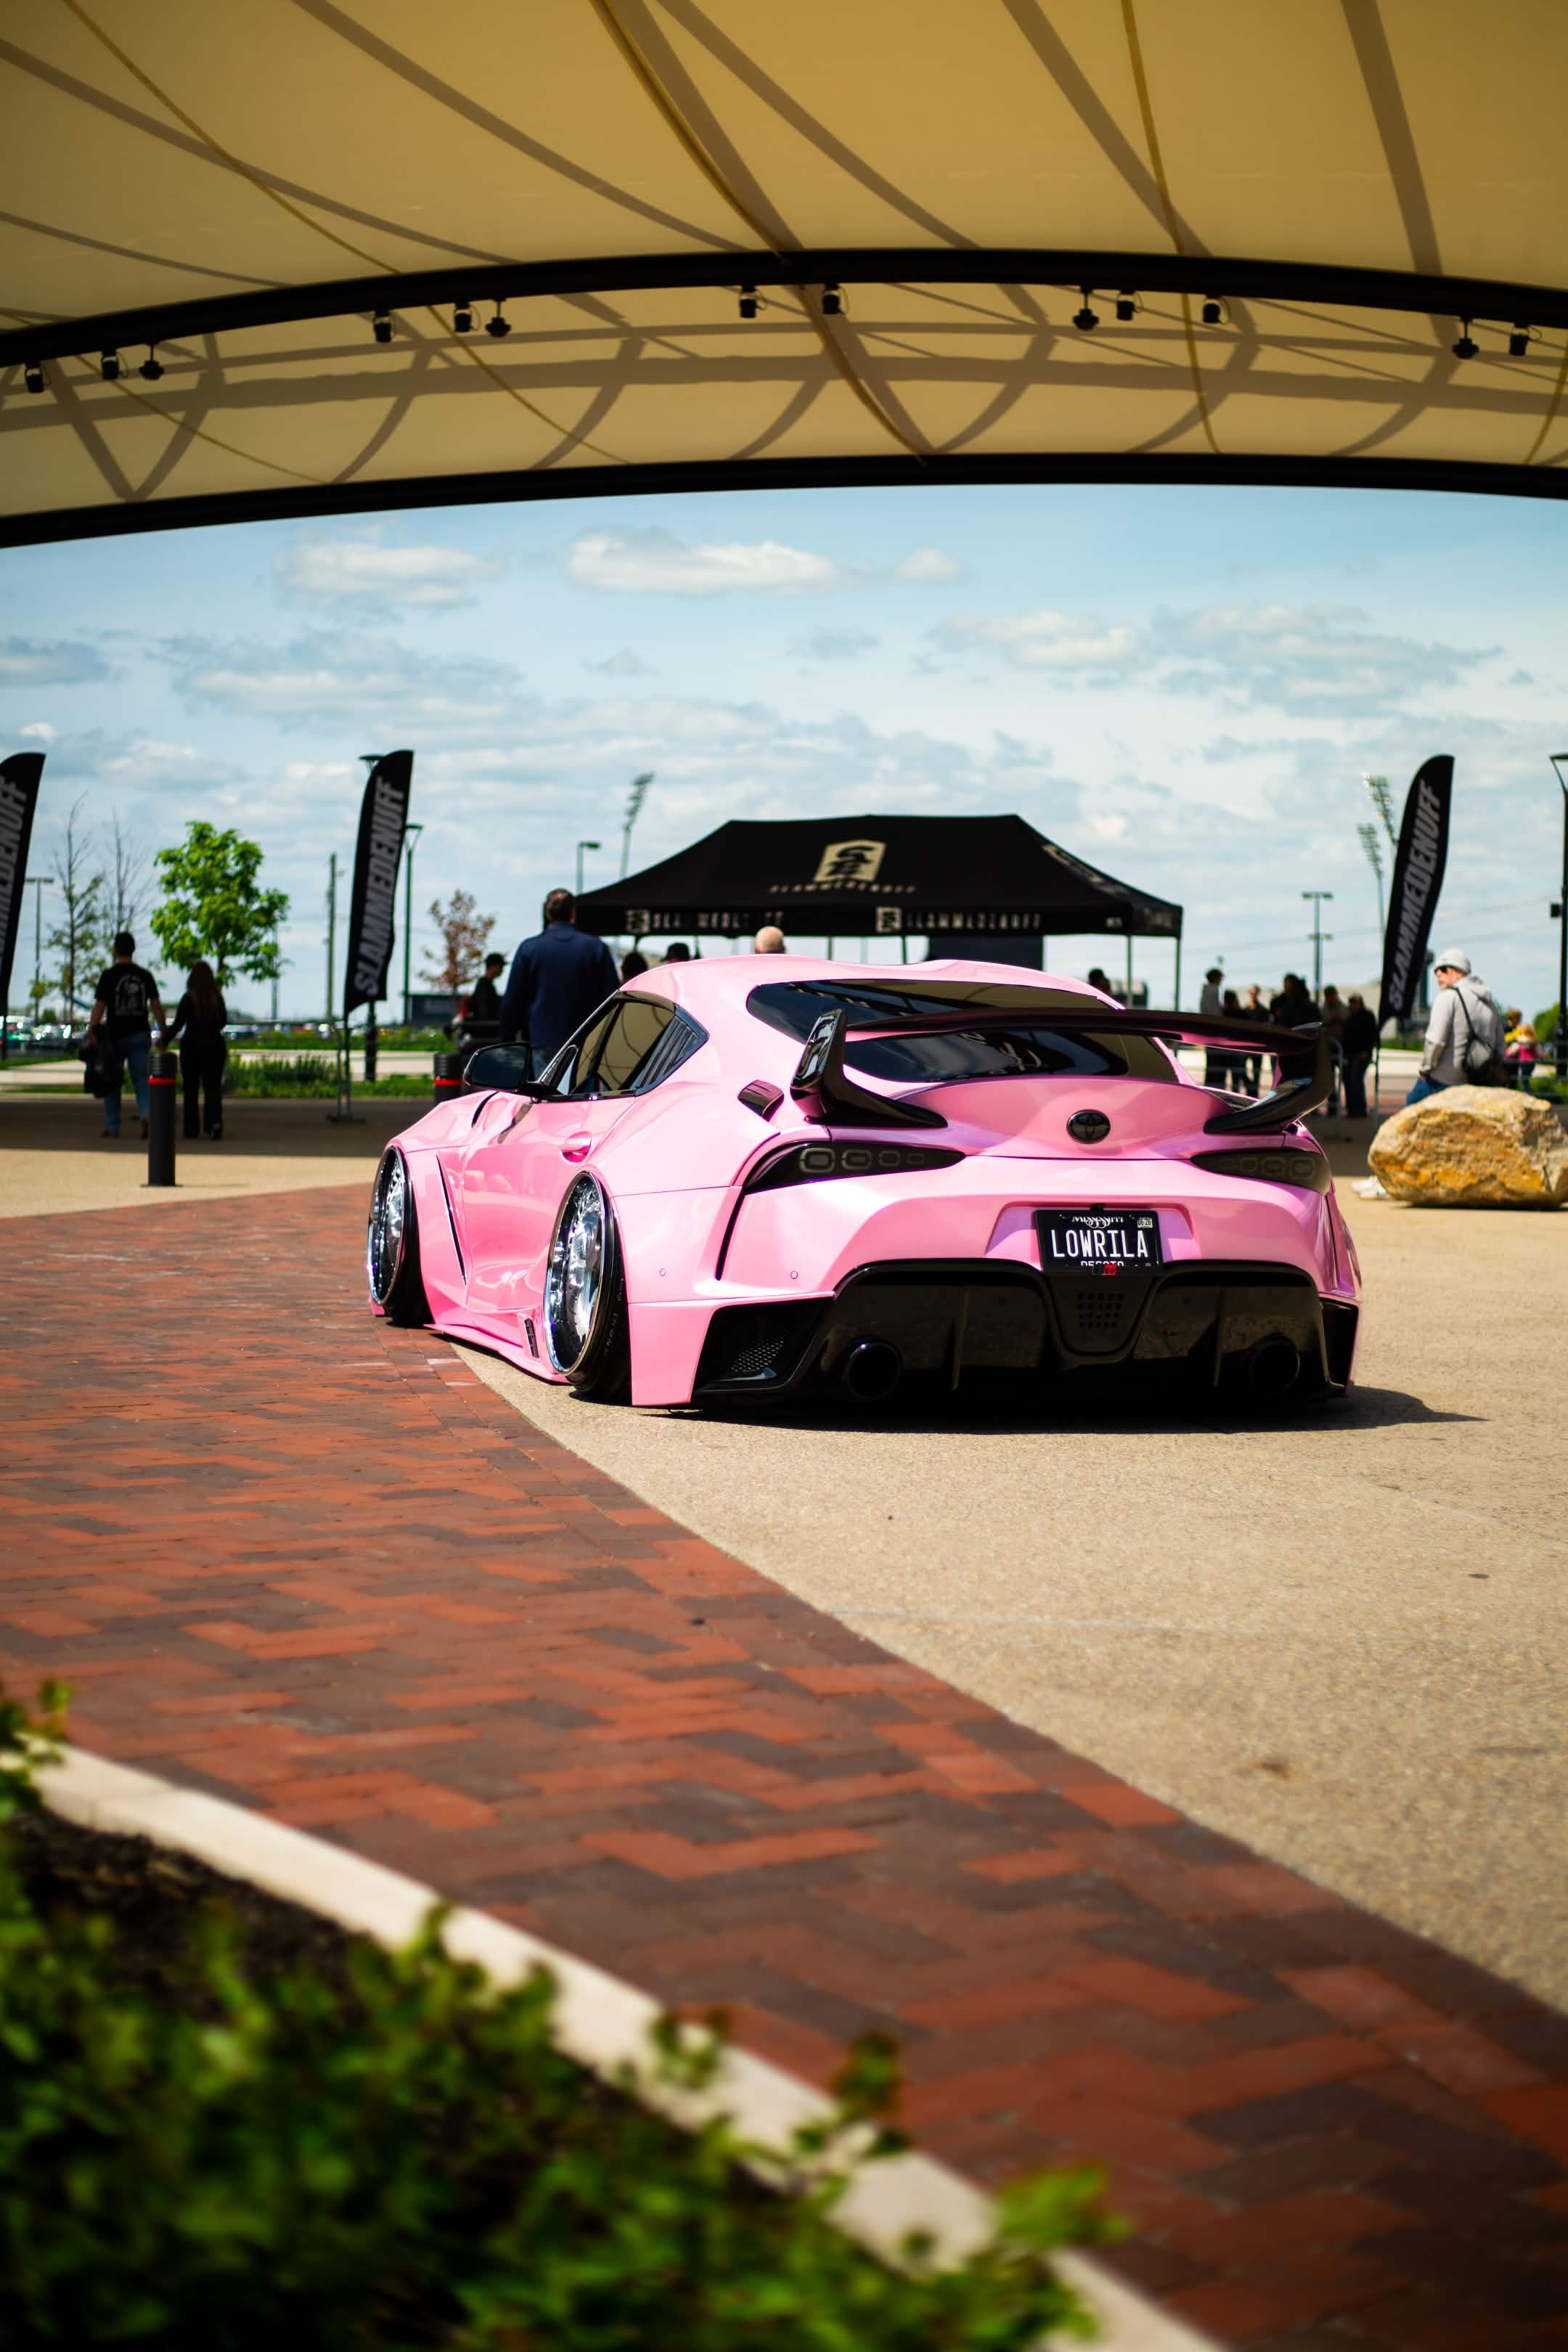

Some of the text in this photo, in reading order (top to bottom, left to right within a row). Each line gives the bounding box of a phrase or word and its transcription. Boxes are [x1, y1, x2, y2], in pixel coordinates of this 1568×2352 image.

[354, 775, 405, 997] SLAMMEDENUFF
[1387, 777, 1441, 1011] SLAMMEDENUFF
[1050, 1230, 1148, 1257] LOWRILA
